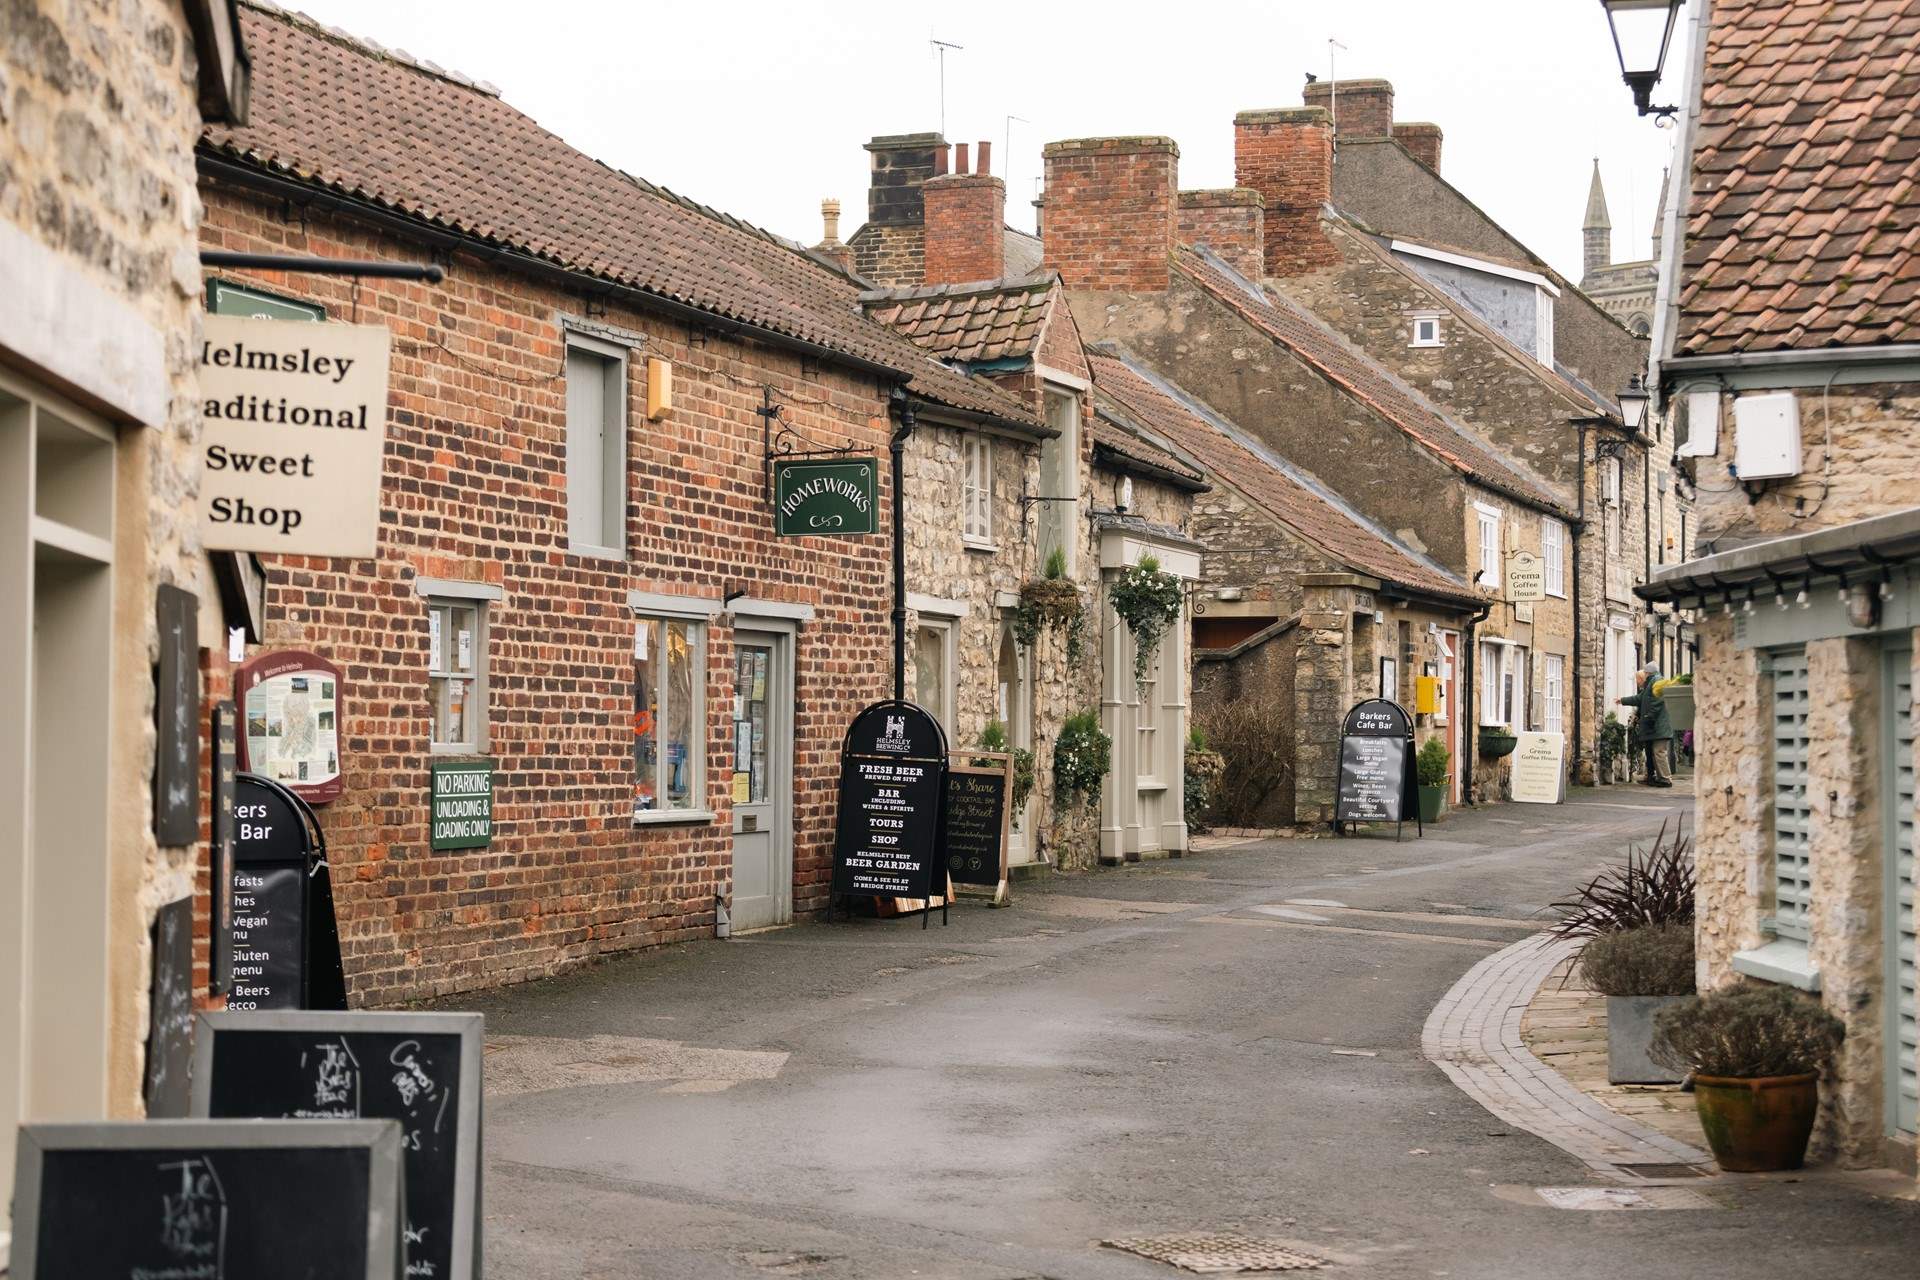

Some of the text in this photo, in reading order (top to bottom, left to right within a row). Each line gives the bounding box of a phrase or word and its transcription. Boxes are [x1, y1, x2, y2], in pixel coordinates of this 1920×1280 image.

[203, 394, 368, 430] aditional
[206, 445, 314, 477] Sweet
[781, 477, 871, 517] HOMEWORKS
[208, 497, 302, 535] Shop
[1360, 712, 1391, 720] Barkers
[1356, 721, 1393, 729] Cafe Bar
[876, 737, 911, 745] HELMSLEY
[859, 764, 924, 776] FRESH BEER
[437, 774, 490, 793] NO PARKING
[966, 777, 997, 793] Share
[878, 788, 900, 798] BAR
[436, 799, 490, 818] UNLOADING &
[435, 819, 490, 839] LOADING ONLY
[869, 818, 904, 828] TOURS
[240, 823, 273, 840] Bar
[871, 835, 898, 845] SHOP
[856, 851, 894, 859] HELMSLEY'S
[845, 858, 921, 871] BEER GARDEN
[234, 875, 264, 887] fasts
[860, 882, 884, 890] BRIDGE
[234, 895, 256, 906] hes
[233, 916, 268, 929] Vegan
[233, 931, 248, 940] nu
[235, 985, 270, 996] Beers
[223, 1001, 257, 1011] secco
